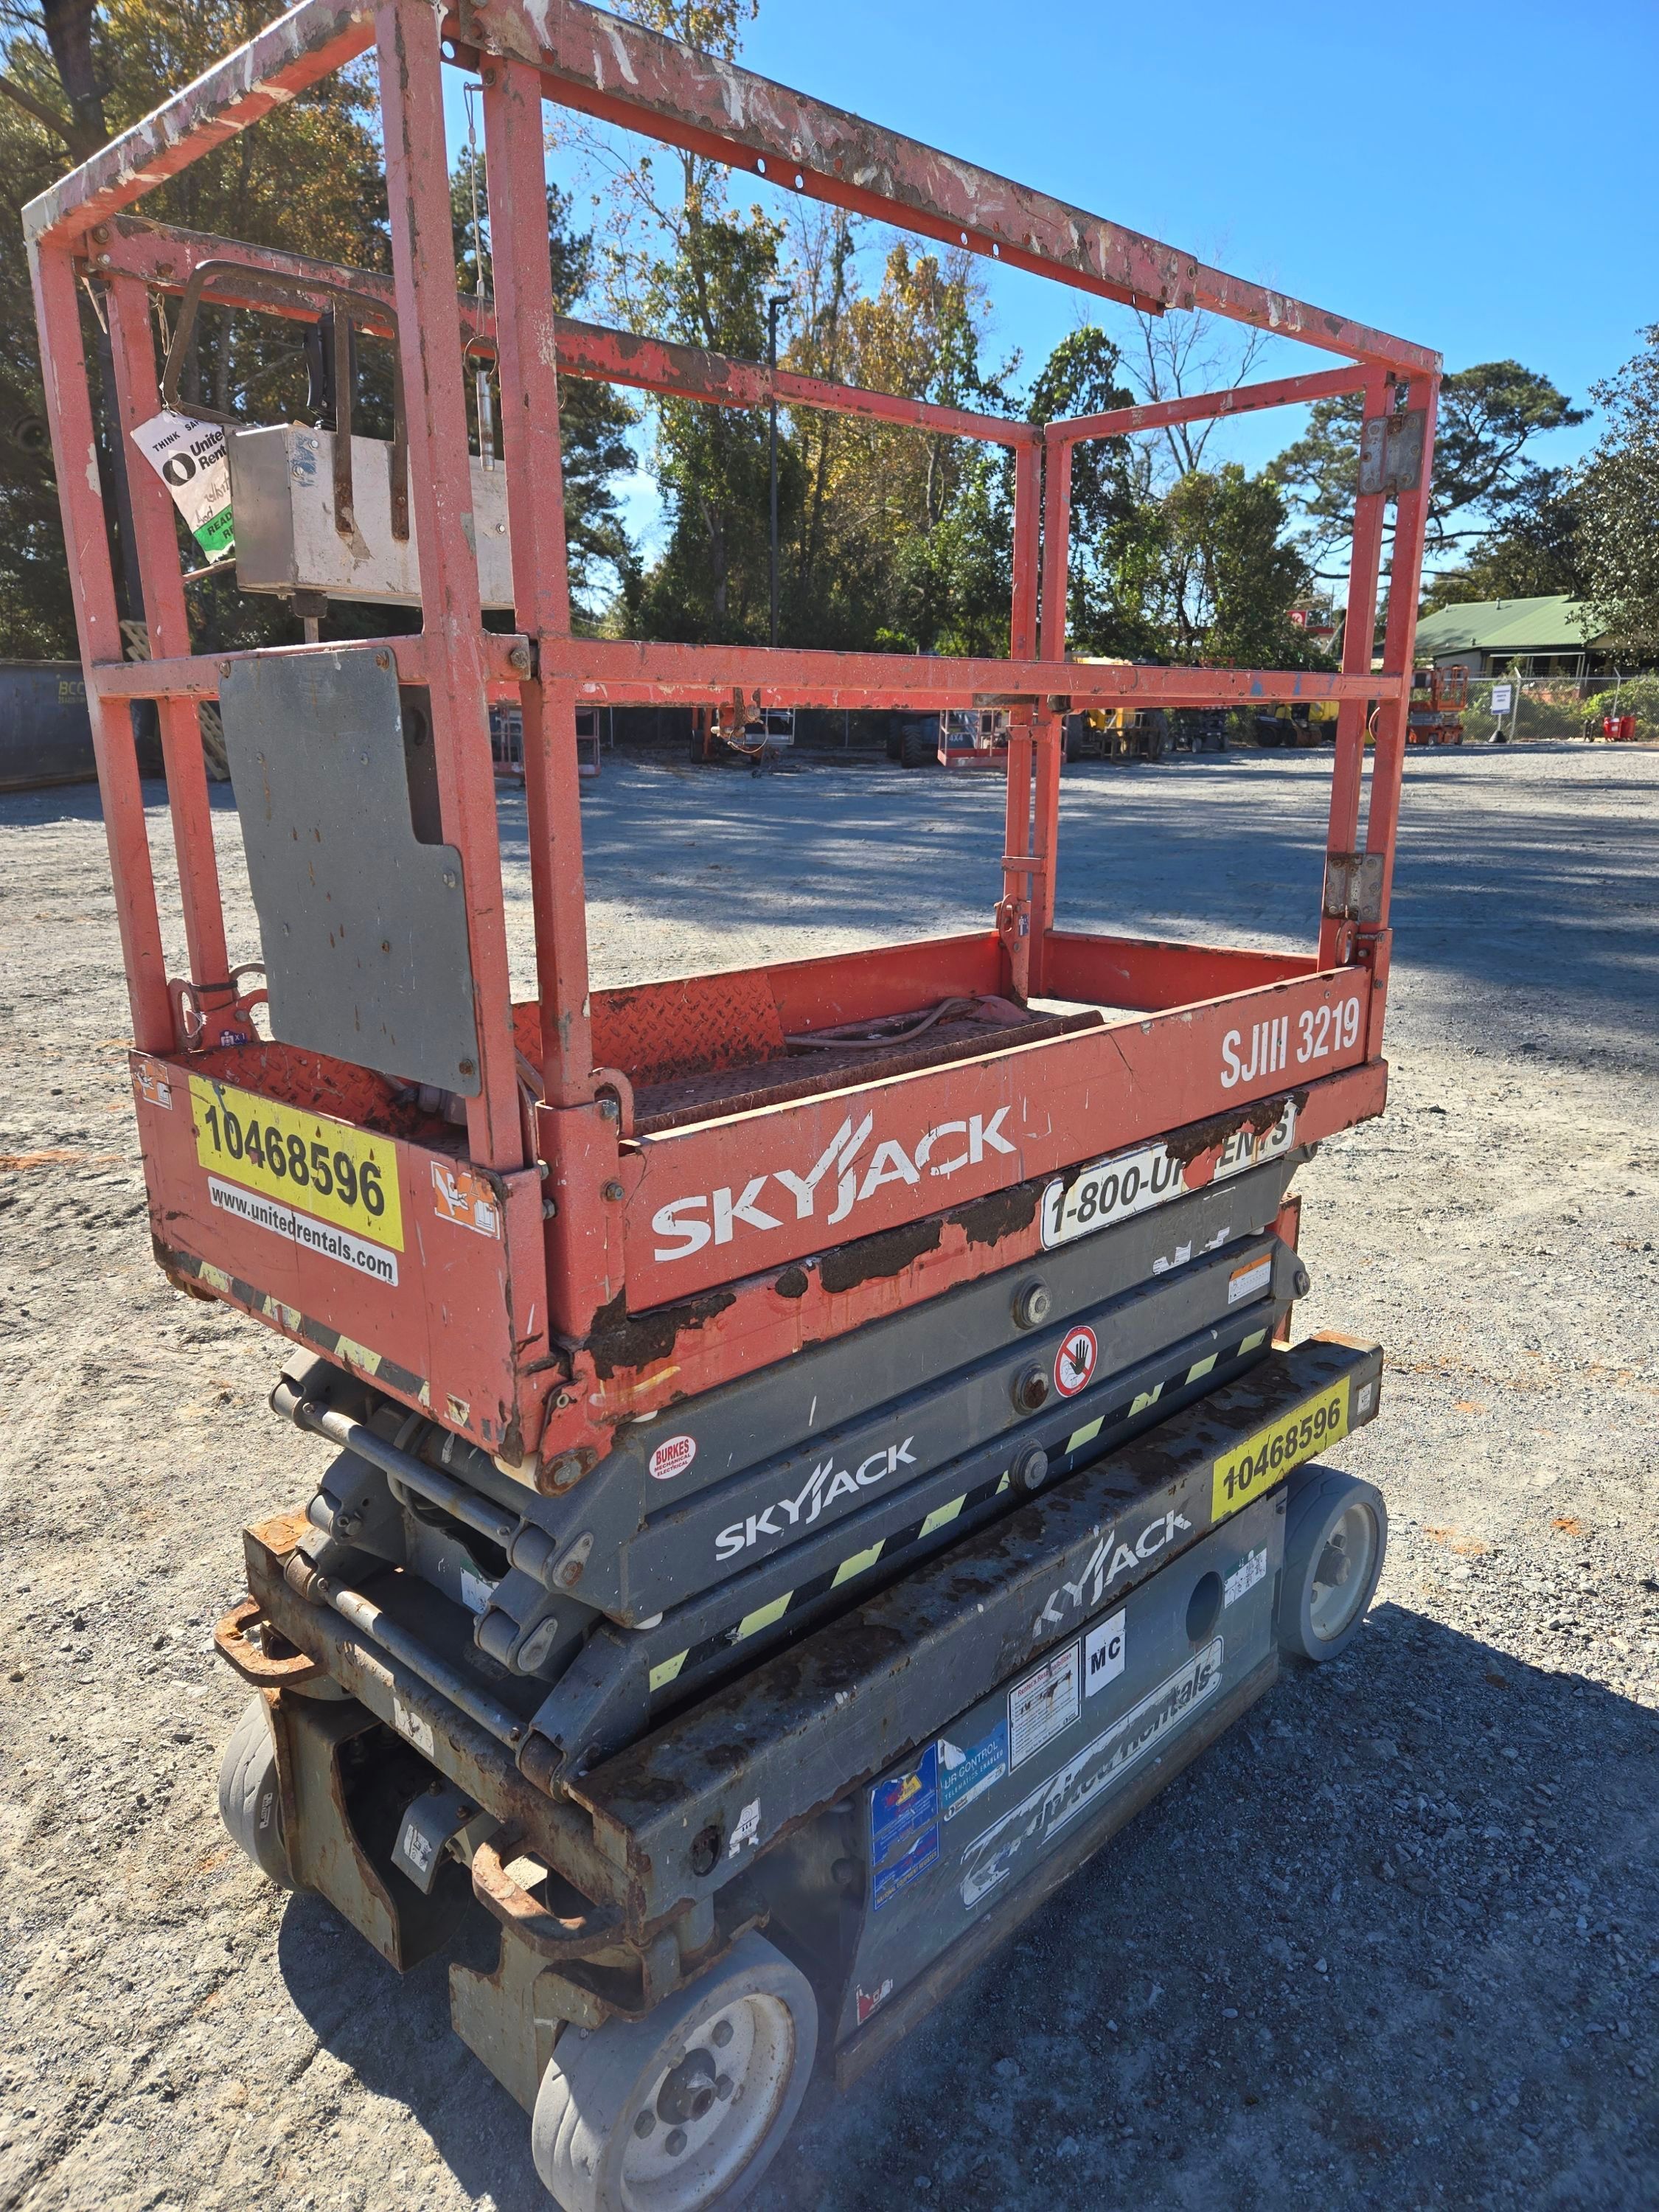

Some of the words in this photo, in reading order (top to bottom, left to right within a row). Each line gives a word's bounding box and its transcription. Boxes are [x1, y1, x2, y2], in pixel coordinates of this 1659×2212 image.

[152, 431, 181, 452] THINK
[1296, 997, 1360, 1064] 3219
[205, 1104, 386, 1216] 10468596
[652, 1105, 1018, 1262] SKYJACK
[211, 1183, 394, 1281] www.unitedrentals.com
[654, 1453, 691, 1472] MECHANICAL
[655, 1439, 689, 1466] BURKES
[657, 1460, 689, 1477] ELECTRICAL
[1222, 1397, 1341, 1500] 10468596
[714, 1435, 918, 1562] SKYJACK
[944, 1773, 957, 1790] UR
[959, 1740, 998, 1778] CONTROL
[945, 1770, 978, 1801] TELEMATICS
[980, 1749, 1004, 1773] ENABLED
